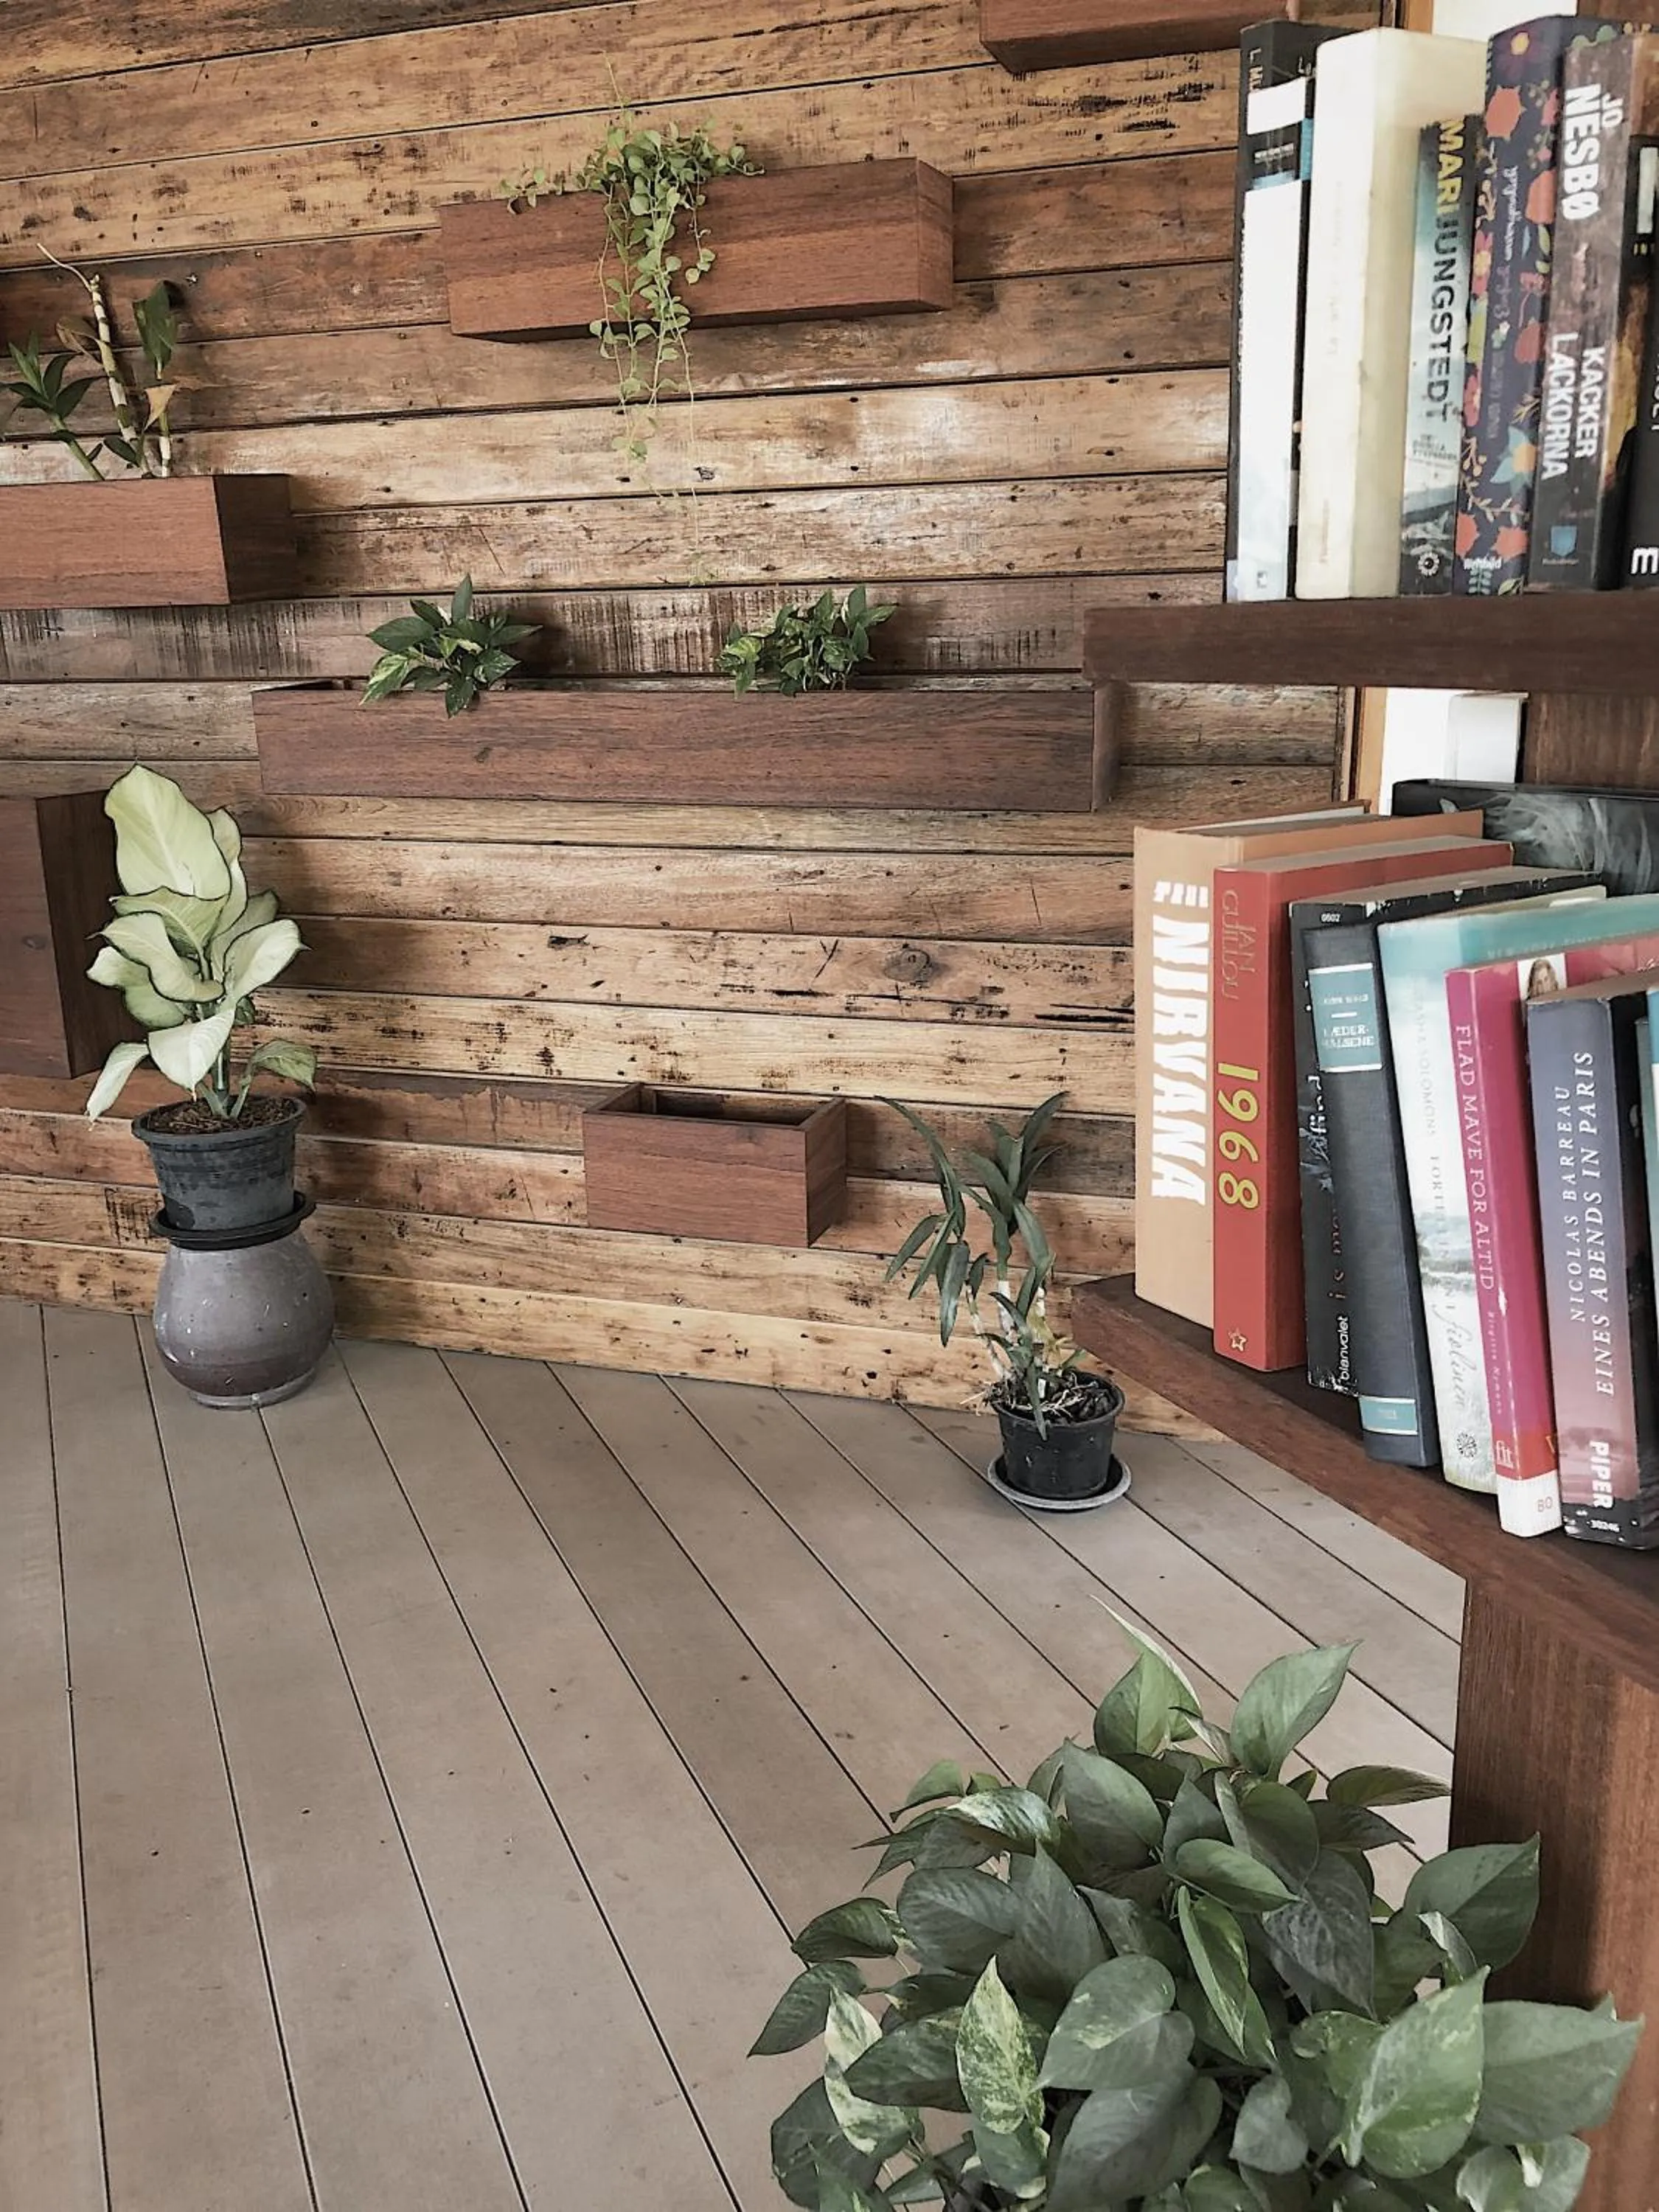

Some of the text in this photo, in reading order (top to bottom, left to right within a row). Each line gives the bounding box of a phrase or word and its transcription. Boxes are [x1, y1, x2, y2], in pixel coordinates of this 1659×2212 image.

[1437, 119, 1466, 214] MARI
[1561, 83, 1601, 220] NESBØ
[1601, 91, 1624, 128] JO
[1425, 216, 1458, 422] JUNGSTEDT
[1540, 331, 1579, 481] LACKORNA
[1574, 347, 1606, 459] KACKER
[1221, 888, 1241, 1001] GUILLOU
[1150, 914, 1209, 1206] NIRVANA
[1217, 1062, 1260, 1210] 1968
[1455, 1025, 1495, 1290] FLAD MAVE FOR ALTID
[1554, 1086, 1586, 1322] NICOLAS BARREAU
[1573, 1051, 1614, 1397] EINES ABENDS IN PARIS
[1337, 1315, 1350, 1380] blanvalet
[1588, 1439, 1615, 1509] PIPER
